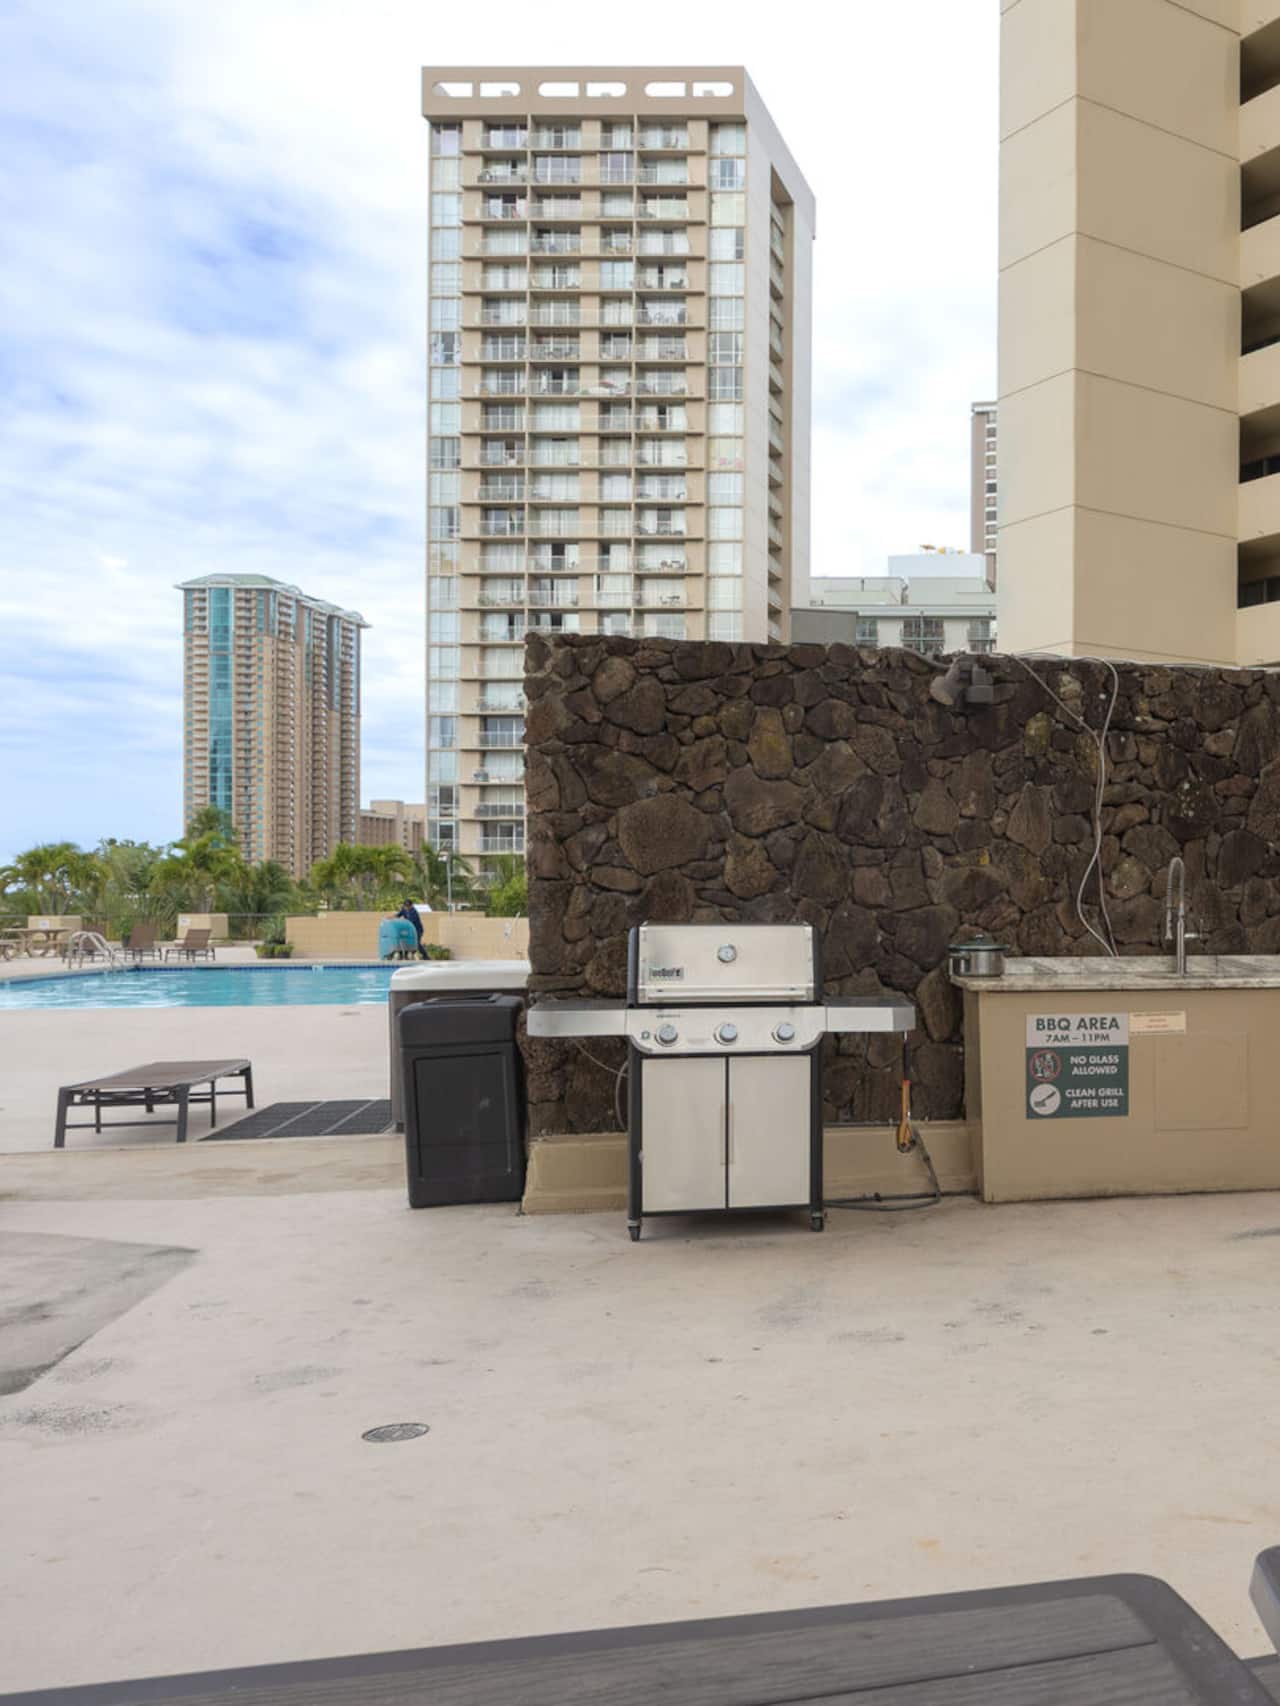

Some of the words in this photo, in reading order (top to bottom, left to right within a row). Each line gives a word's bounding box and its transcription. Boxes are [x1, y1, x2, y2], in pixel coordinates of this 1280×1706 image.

[1036, 1017, 1071, 1031] BBQ
[1076, 1016, 1120, 1030] AREA
[1045, 1034, 1070, 1043] 7AM
[1082, 1033, 1110, 1042] 11PM
[1070, 1055, 1087, 1065] NO
[1088, 1054, 1119, 1065] GLASS
[1072, 1065, 1118, 1075] ALLOWED
[1065, 1088, 1096, 1098] CLEAN
[1098, 1087, 1124, 1097] GRILL
[1071, 1099, 1098, 1108] AFTER
[1101, 1098, 1119, 1107] USE
